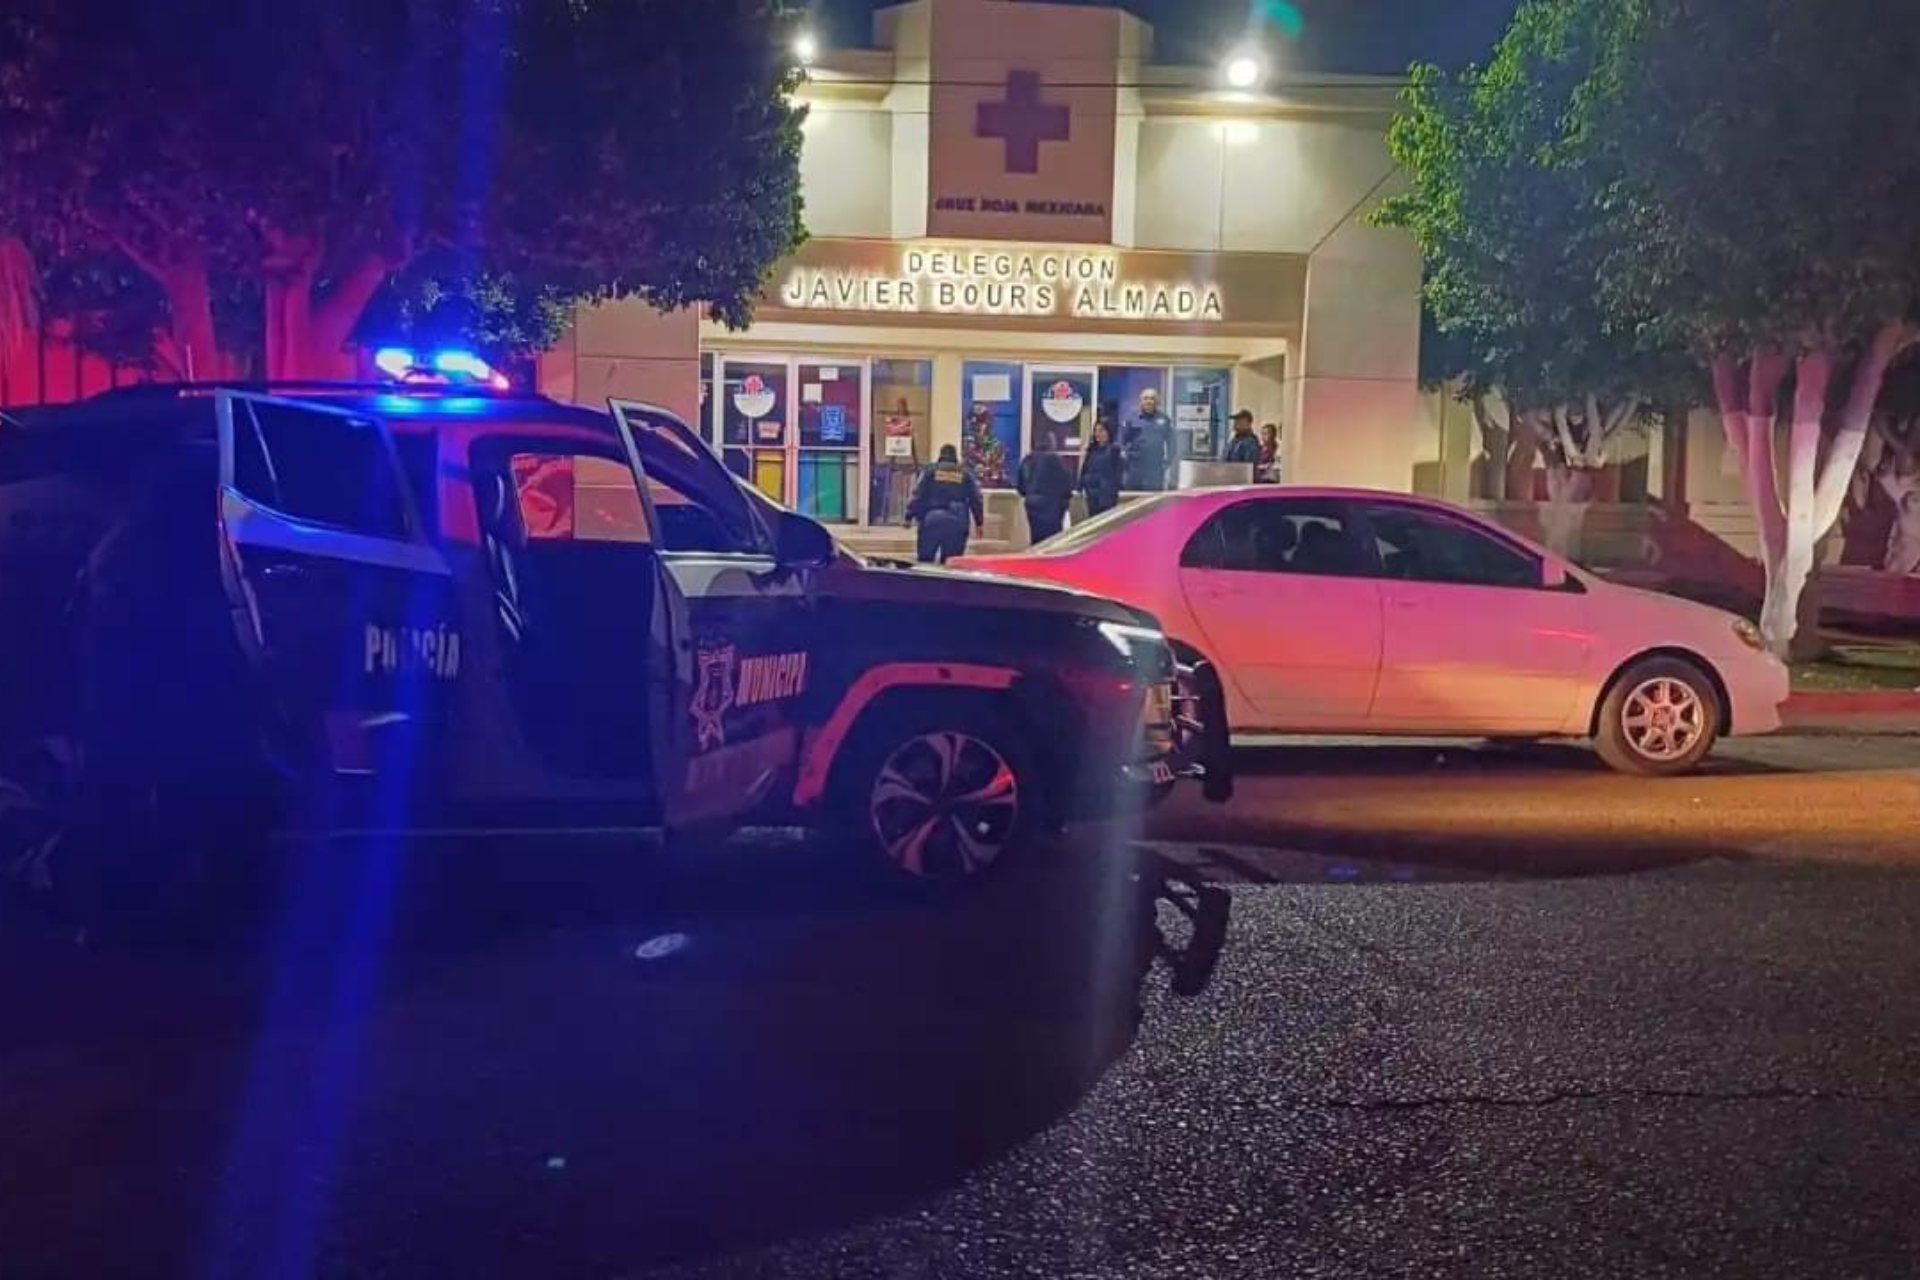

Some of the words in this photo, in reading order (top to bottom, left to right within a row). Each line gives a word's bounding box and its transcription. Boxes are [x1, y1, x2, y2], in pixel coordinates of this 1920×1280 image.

[907, 252, 1115, 280] DELEGACION
[789, 276, 915, 305] JAVIER
[939, 281, 1051, 309] BOURS
[1076, 287, 1221, 314] ALMADA
[364, 622, 460, 679] POICÍA
